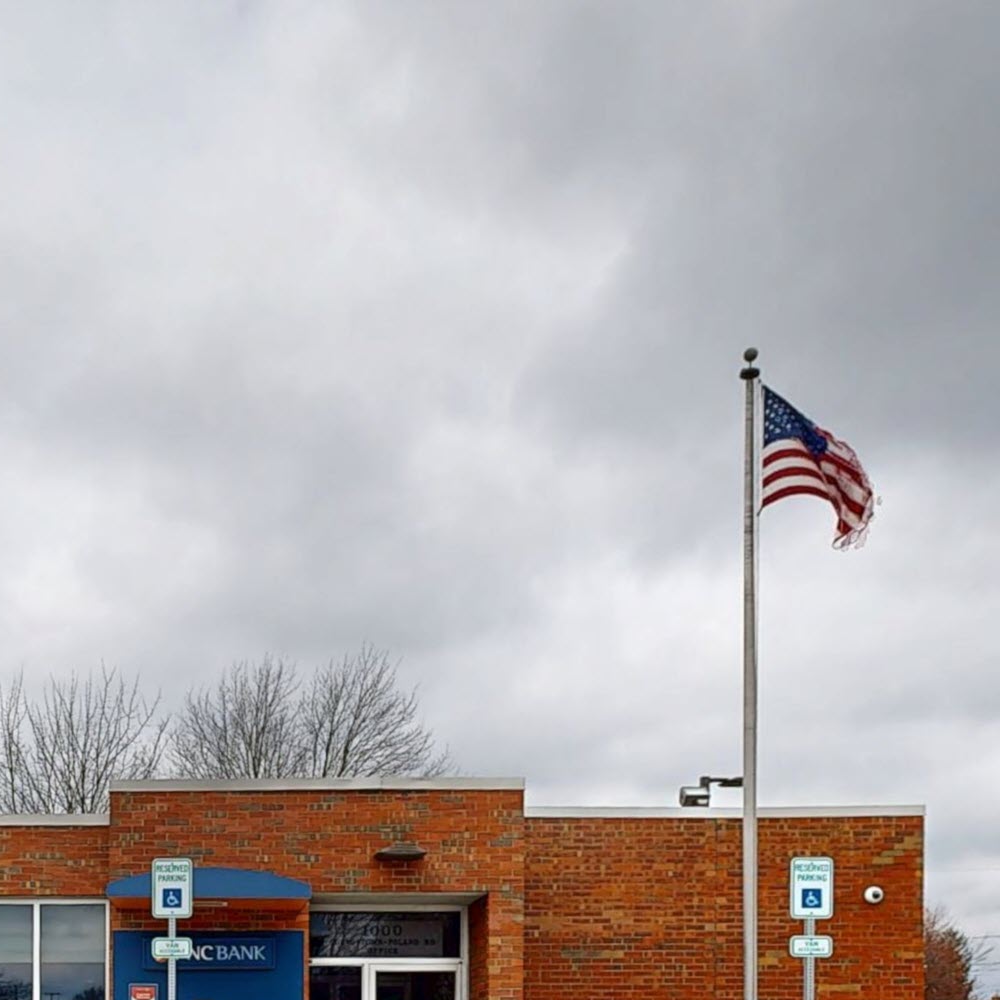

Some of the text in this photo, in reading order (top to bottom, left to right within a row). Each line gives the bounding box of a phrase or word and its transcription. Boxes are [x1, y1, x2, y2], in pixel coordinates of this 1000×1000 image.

[158, 874, 187, 882] PARKING
[797, 874, 828, 882] PARKING
[191, 945, 266, 960] NC BANK
